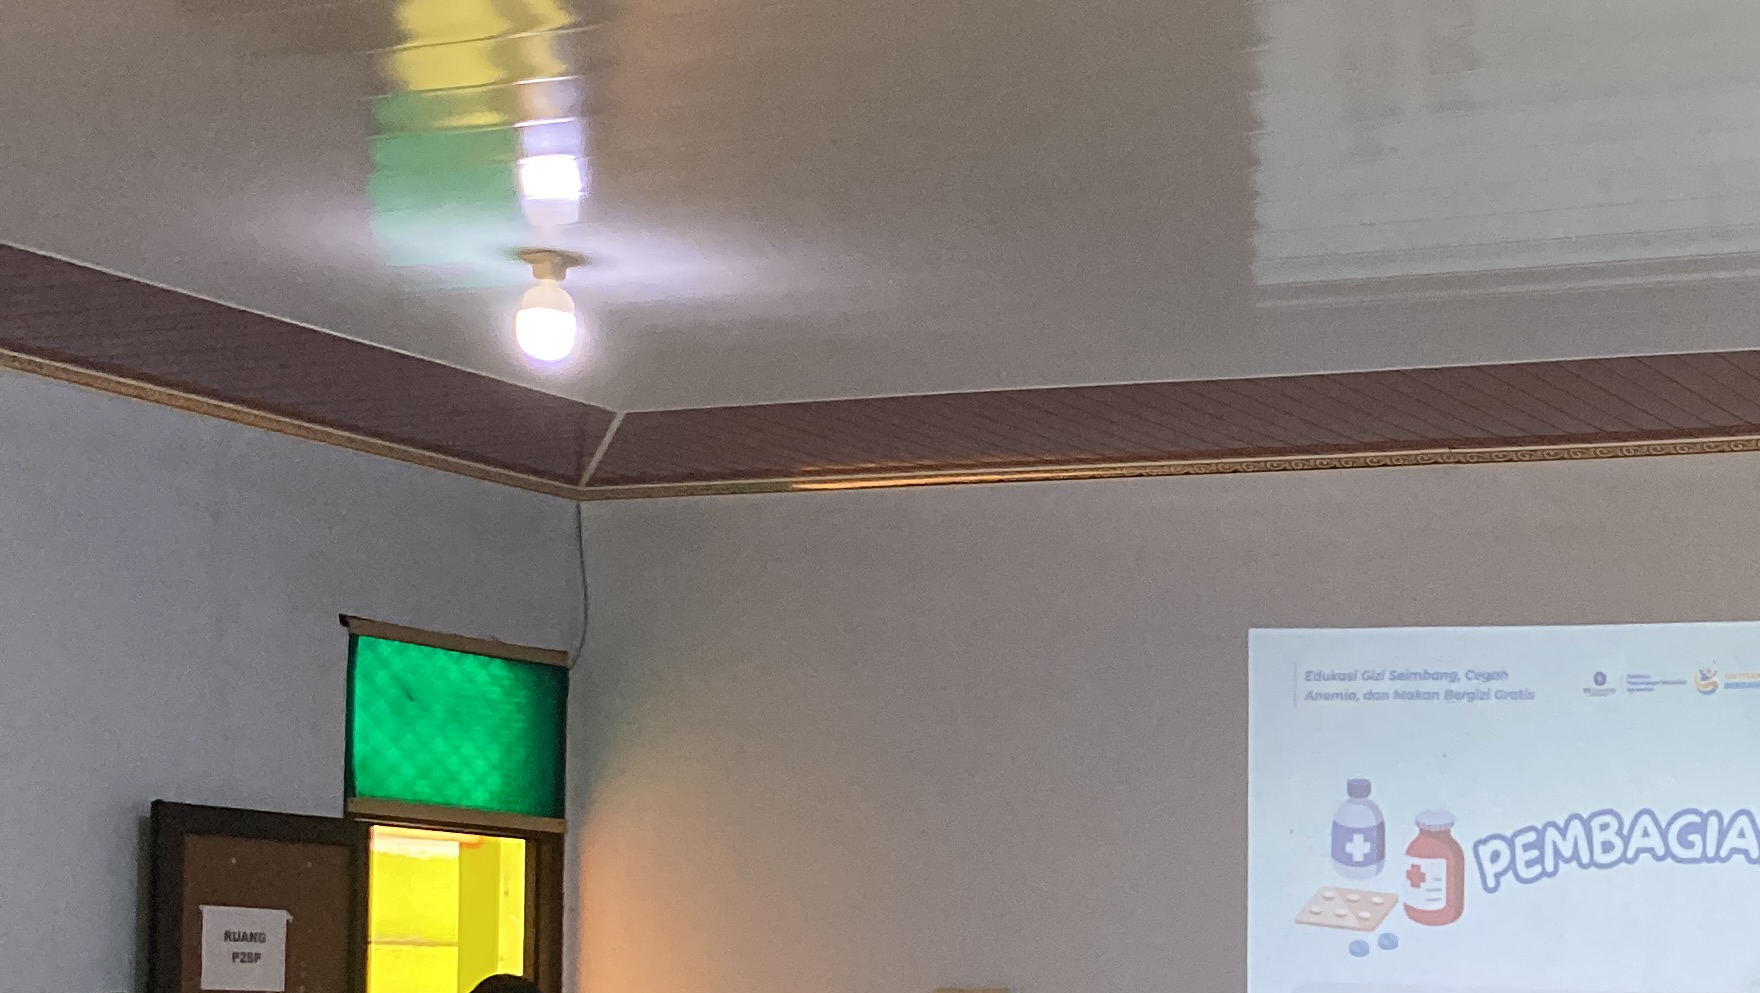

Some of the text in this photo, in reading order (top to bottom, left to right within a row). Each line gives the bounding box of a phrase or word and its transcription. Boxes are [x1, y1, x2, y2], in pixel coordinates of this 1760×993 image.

[1304, 669, 1357, 682] Edukasi
[1361, 669, 1384, 682] Gizi
[1389, 669, 1461, 683] Seimbang,
[1304, 688, 1535, 703] Anemia, dan Makan Bergizi Gratis
[224, 930, 267, 943] RUANG
